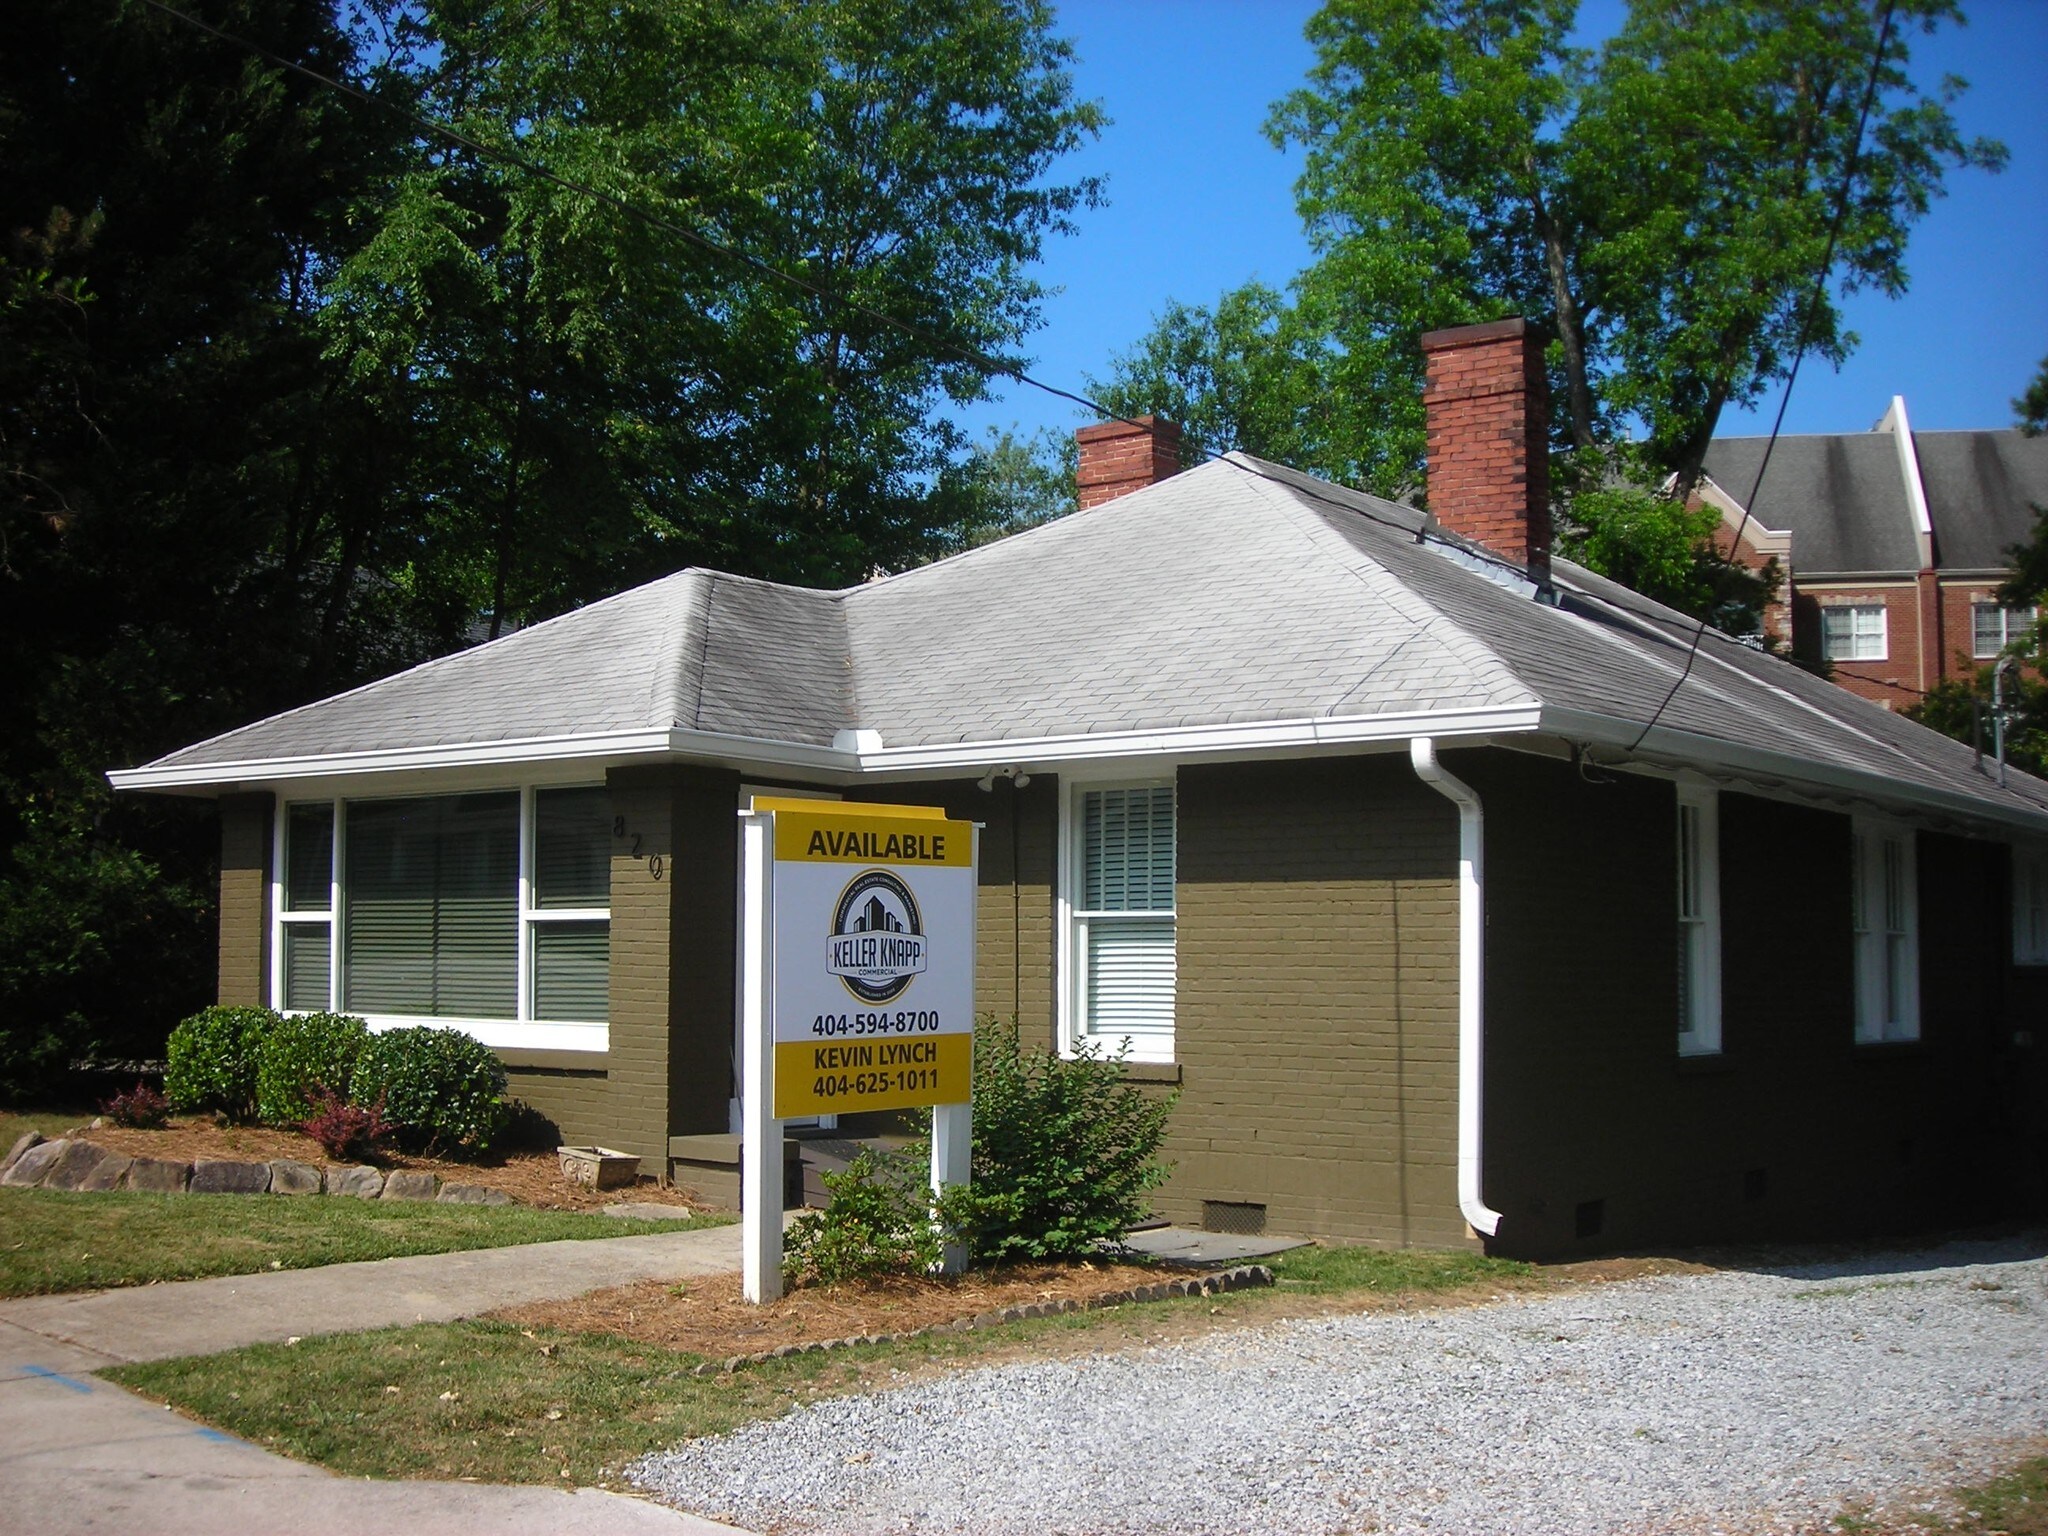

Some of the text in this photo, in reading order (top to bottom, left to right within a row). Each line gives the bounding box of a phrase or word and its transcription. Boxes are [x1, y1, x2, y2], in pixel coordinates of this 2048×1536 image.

[613, 815, 663, 880] 820
[807, 830, 945, 860] AVAILABLE
[834, 938, 920, 968] KELLER KNAPP
[858, 968, 898, 976] COMMERCIAL
[812, 1011, 939, 1036] 404-594-8700
[814, 1042, 937, 1069] KEVIN LYNCH
[813, 1069, 938, 1097] 404-625-1011
